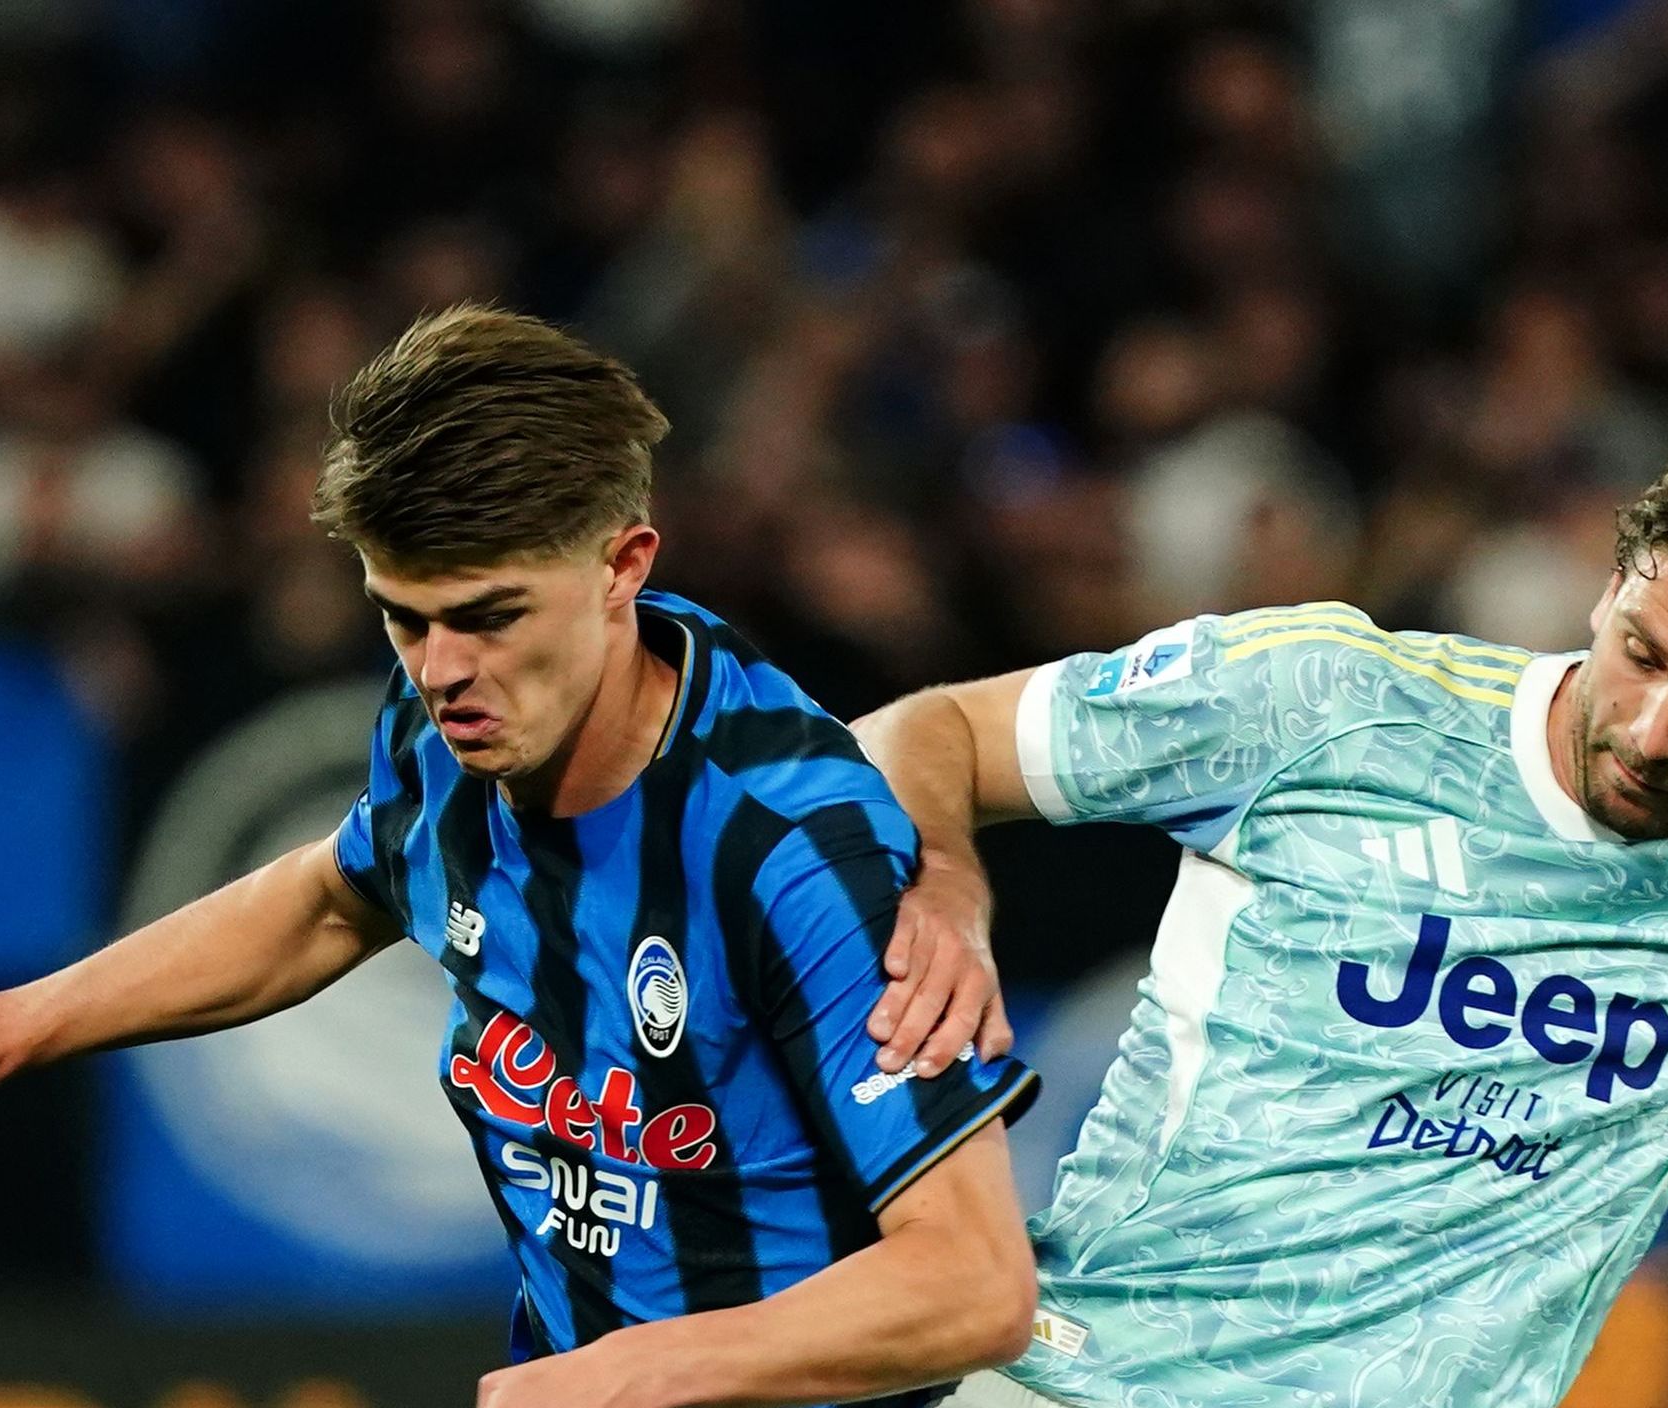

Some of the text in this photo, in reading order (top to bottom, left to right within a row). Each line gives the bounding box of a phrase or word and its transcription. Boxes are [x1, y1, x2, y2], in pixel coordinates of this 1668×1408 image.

[450, 1009, 717, 1171] Lete
[1433, 1070, 1544, 1121] VISIT
[1367, 1091, 1561, 1181] Detroit
[536, 1209, 621, 1259] FUN
